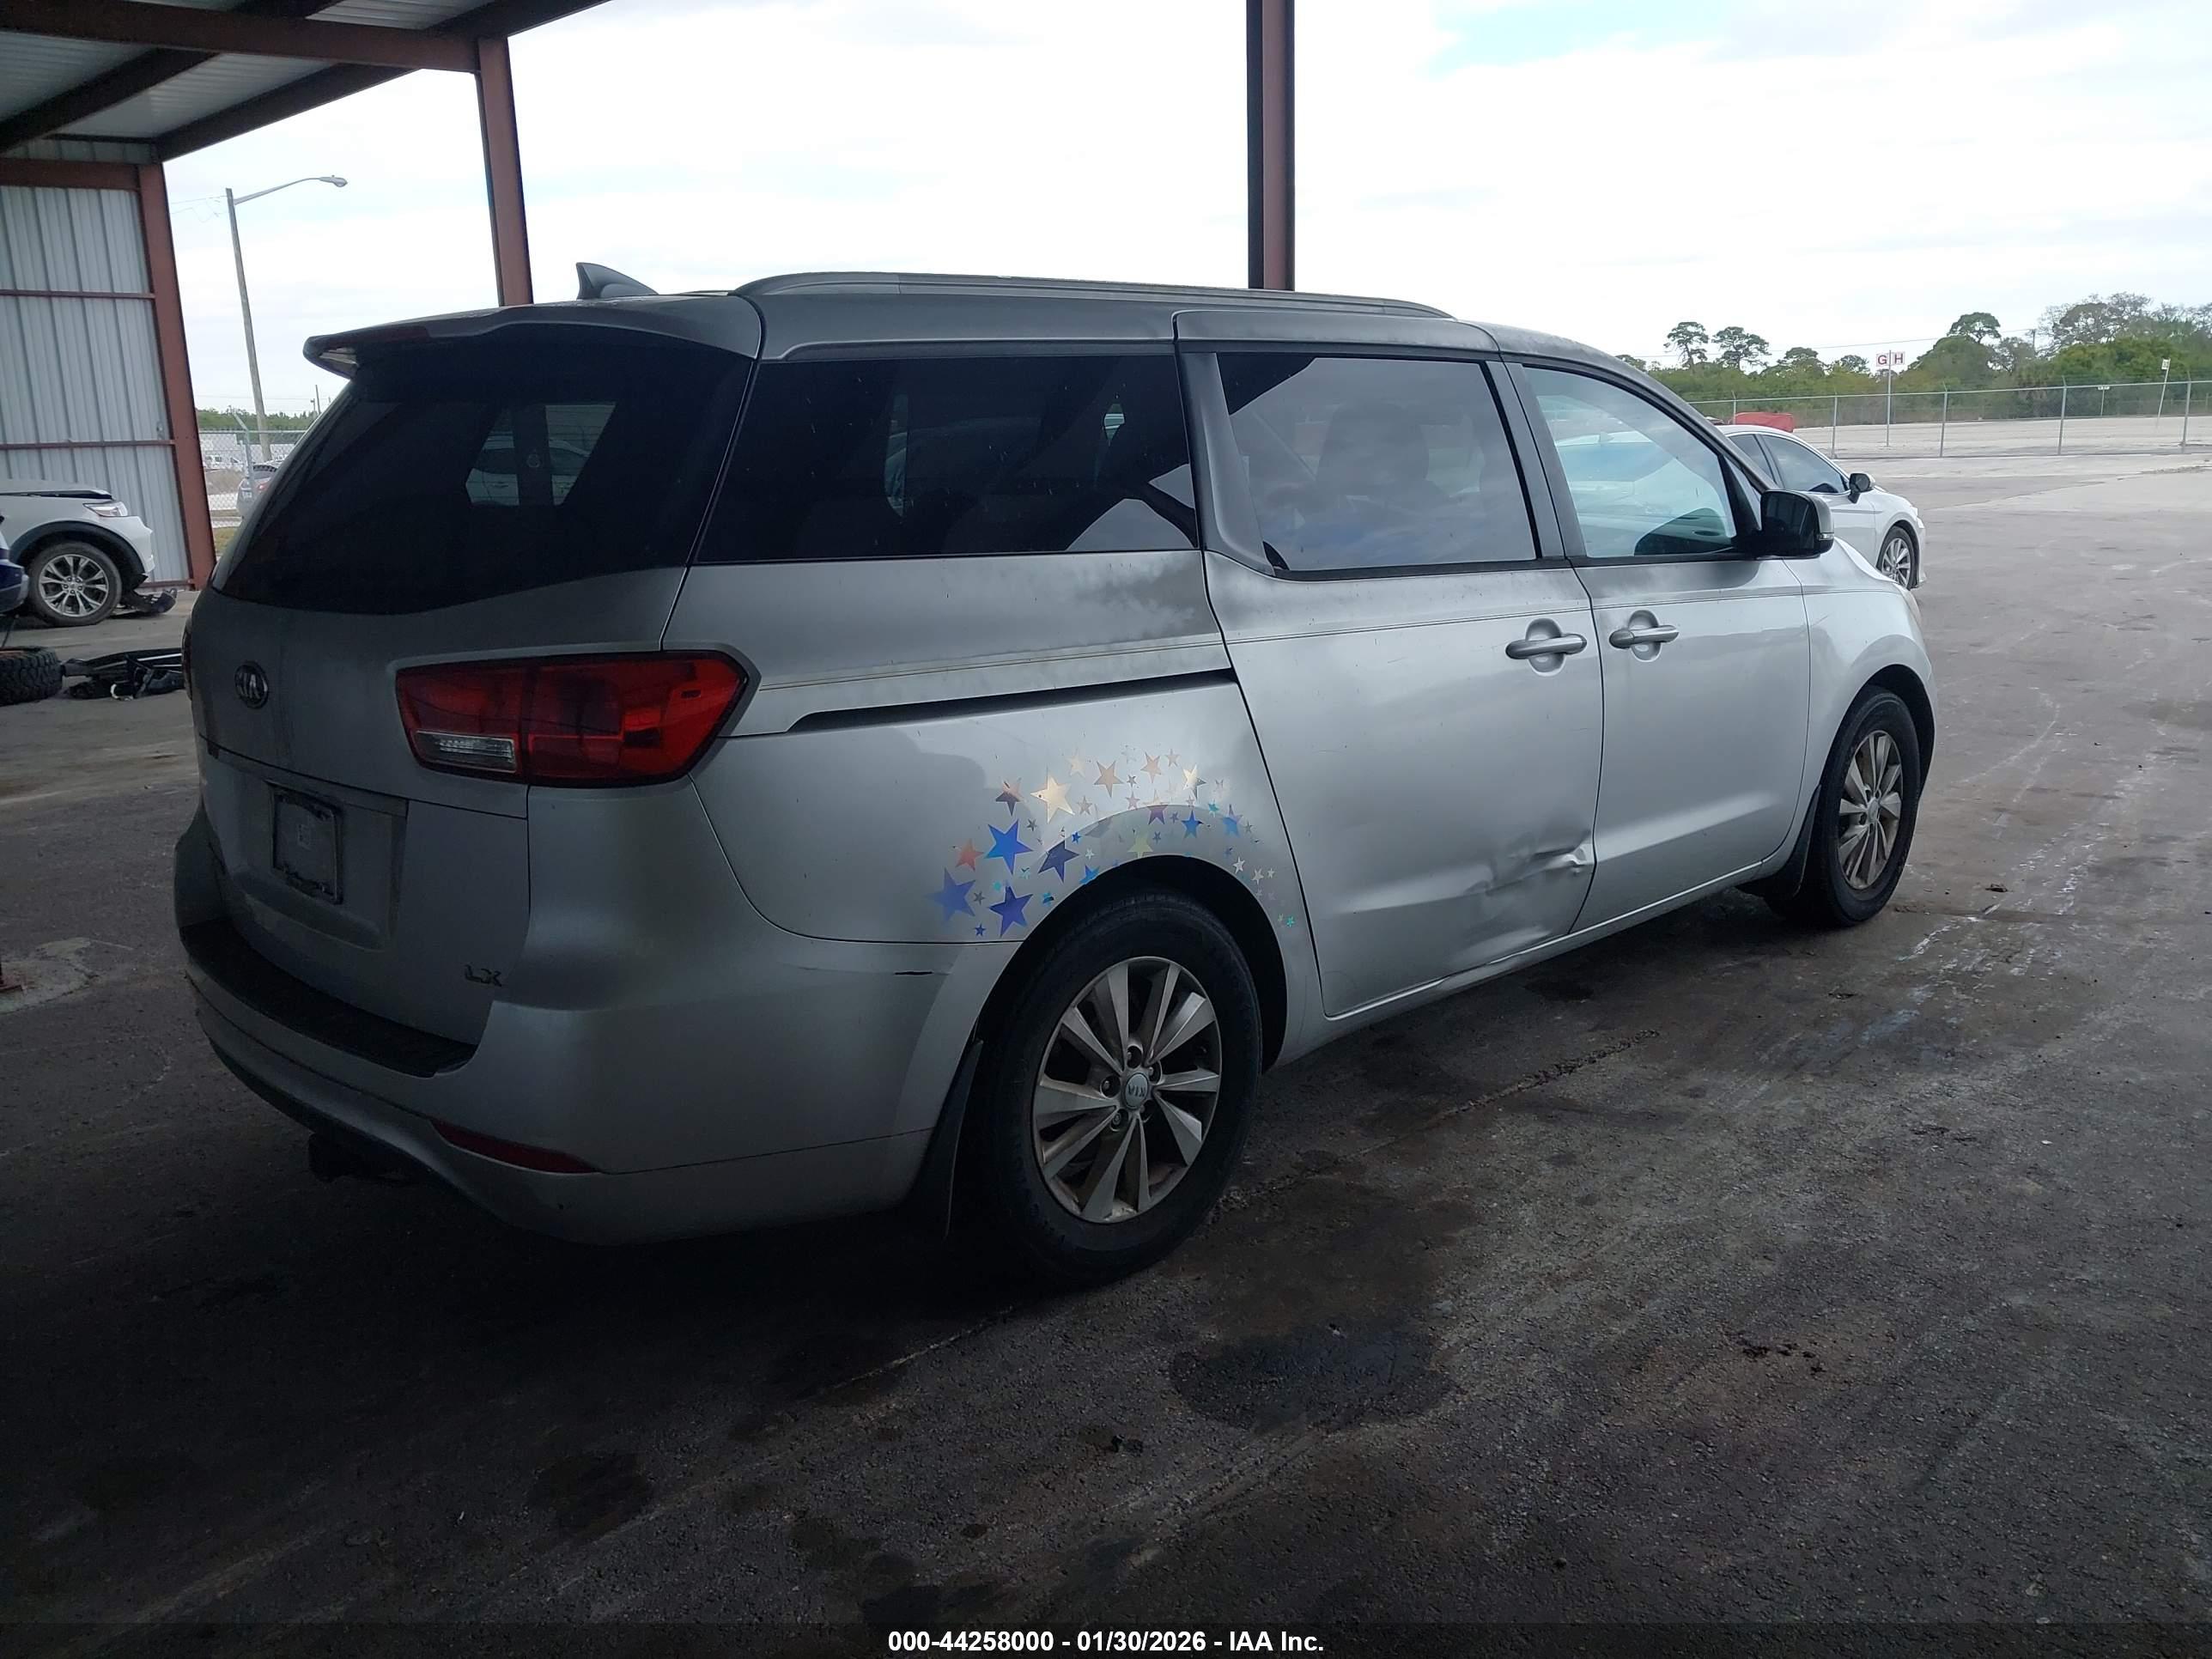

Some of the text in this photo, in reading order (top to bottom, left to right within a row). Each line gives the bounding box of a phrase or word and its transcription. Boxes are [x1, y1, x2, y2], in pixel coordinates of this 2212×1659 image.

[1878, 355, 1887, 365] G
[1894, 353, 1904, 364] H
[464, 963, 502, 988] LX
